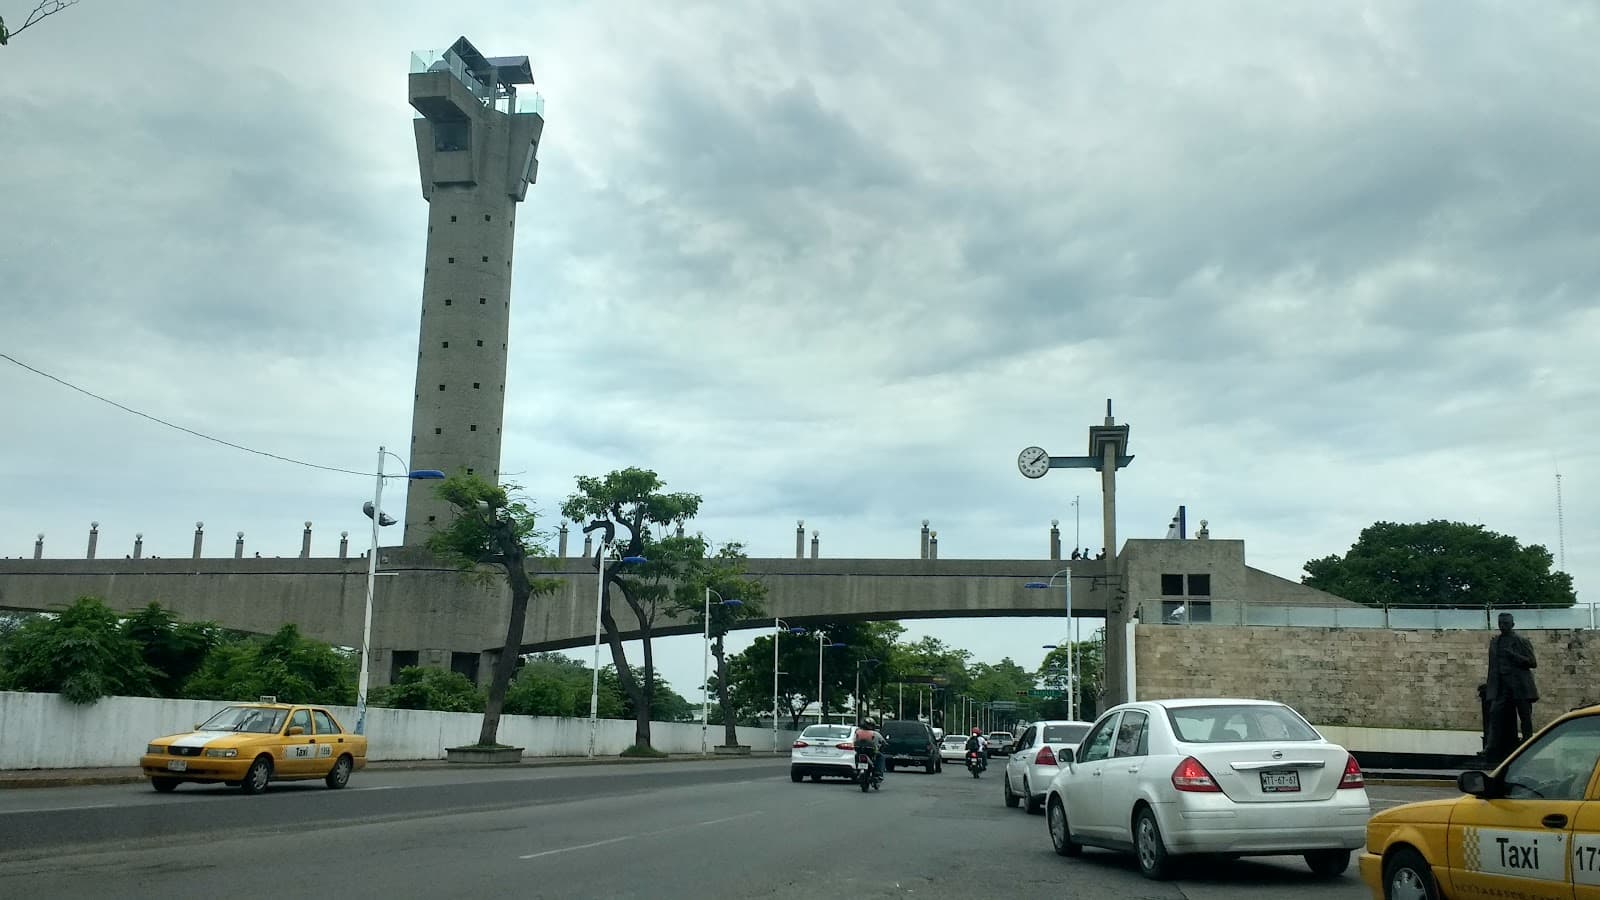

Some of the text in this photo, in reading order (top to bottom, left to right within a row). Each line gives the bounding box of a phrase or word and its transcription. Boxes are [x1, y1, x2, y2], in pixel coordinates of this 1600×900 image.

[296, 746, 309, 757] Taxi
[1496, 837, 1600, 871] Taxi 17
